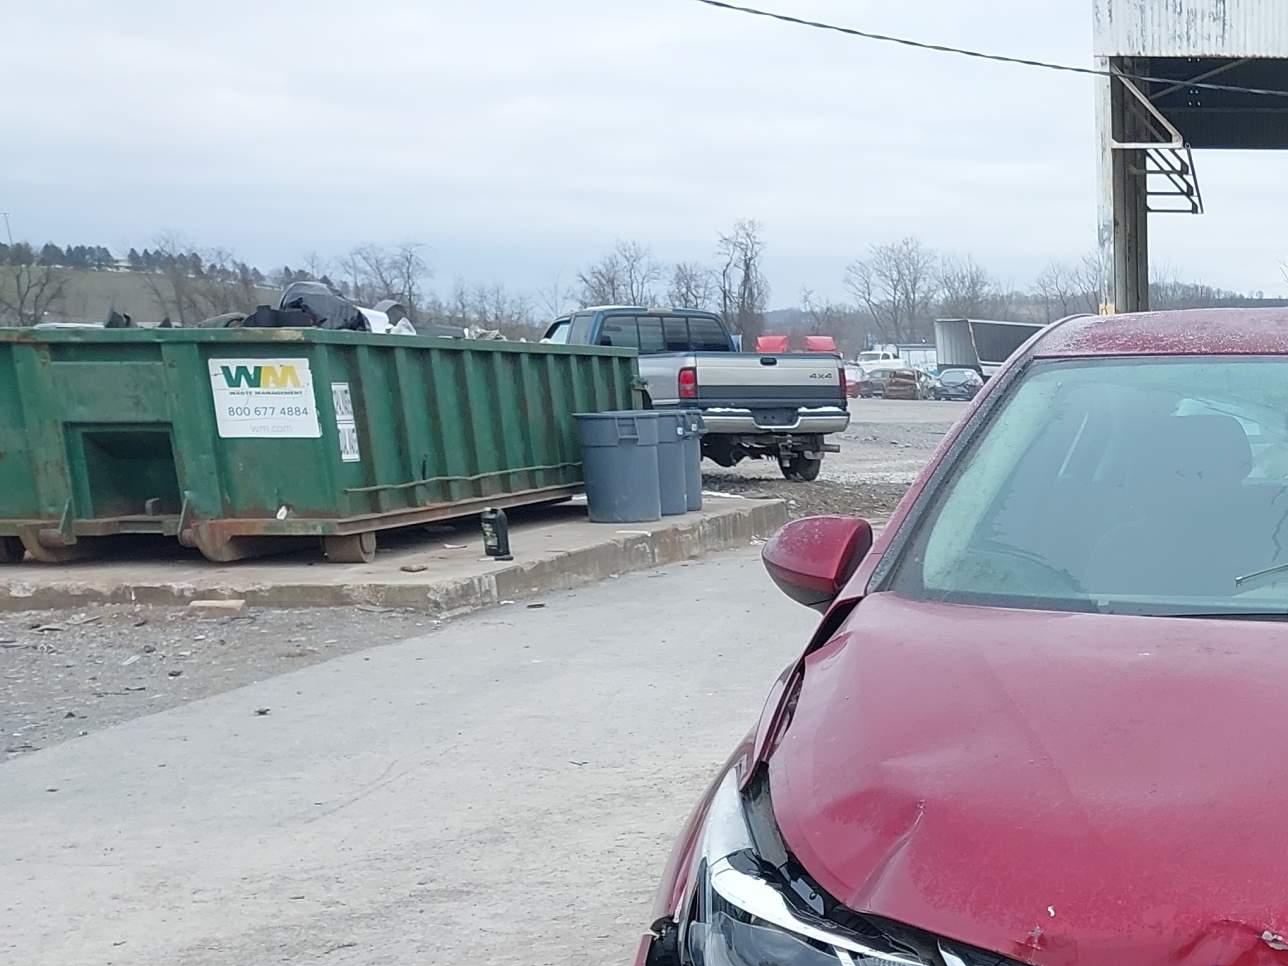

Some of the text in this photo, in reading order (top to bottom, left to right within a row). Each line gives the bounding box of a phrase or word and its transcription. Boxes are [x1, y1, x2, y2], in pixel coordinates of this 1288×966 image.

[220, 365, 304, 388] WM
[228, 406, 309, 417] 800 677 4884
